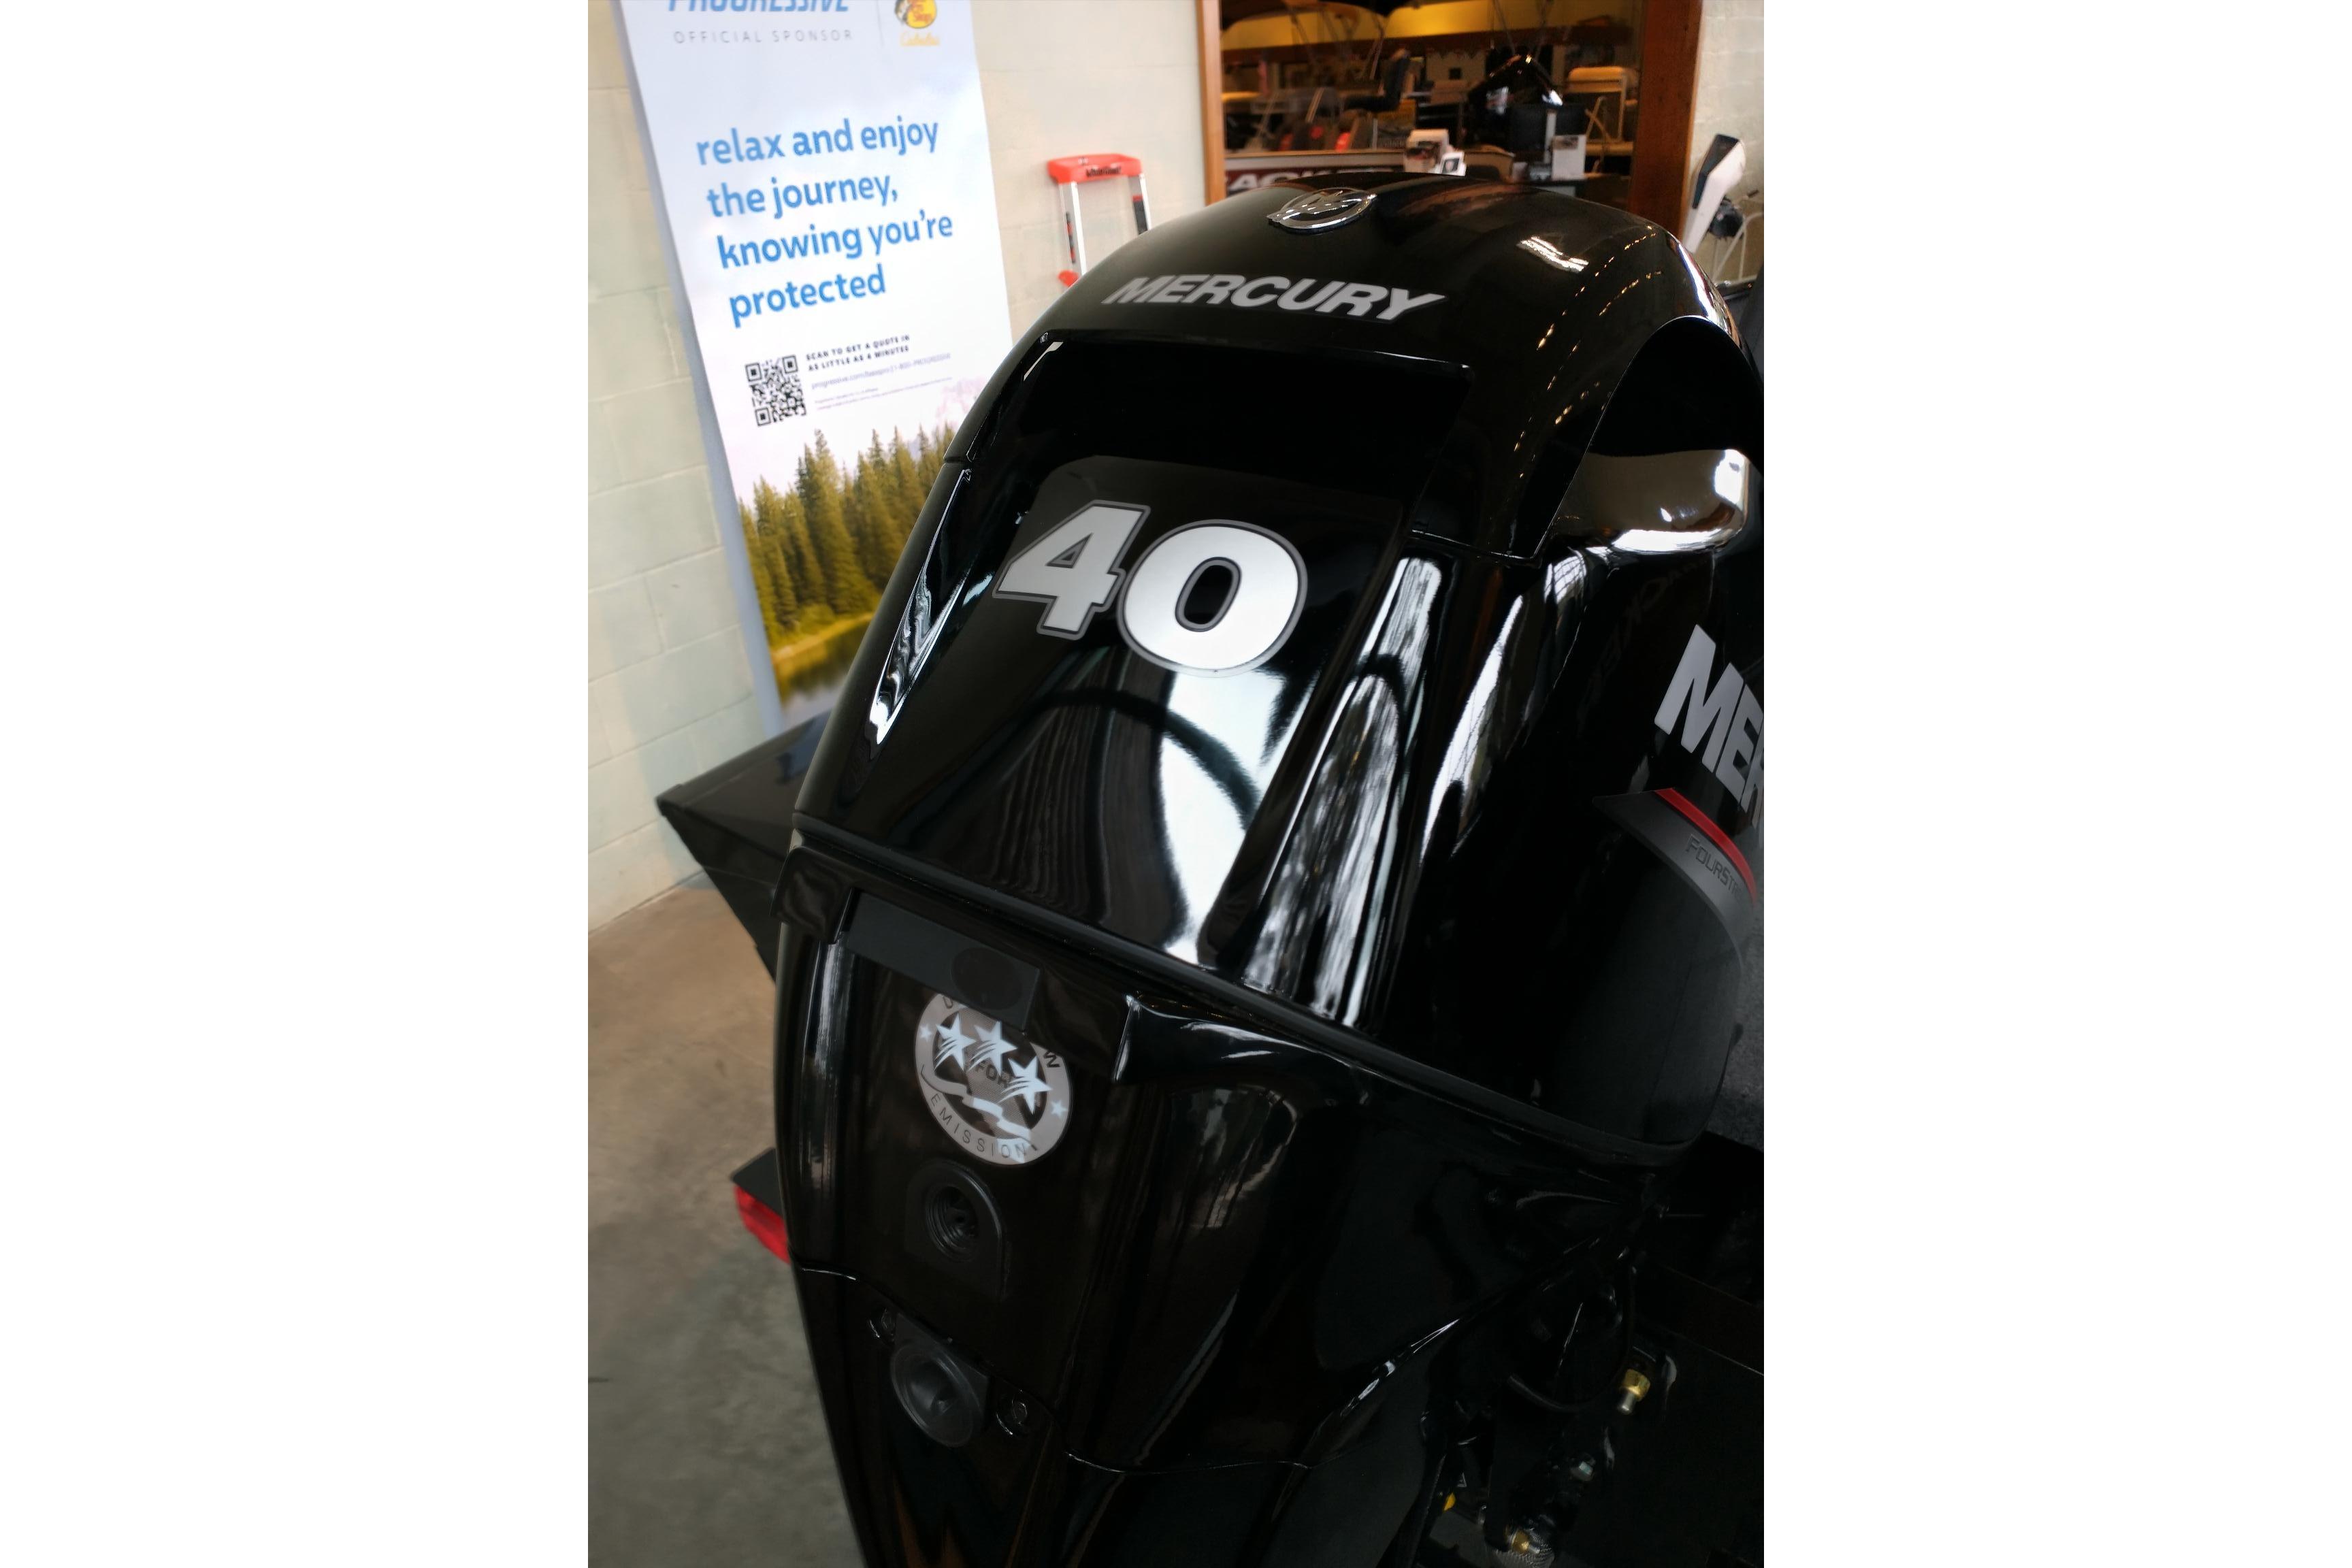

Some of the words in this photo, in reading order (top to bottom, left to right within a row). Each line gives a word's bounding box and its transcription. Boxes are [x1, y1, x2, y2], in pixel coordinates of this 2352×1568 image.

[673, 31, 762, 44] OFFICIAL
[772, 29, 853, 42] SPONSOR
[696, 128, 785, 166] relax
[792, 118, 854, 155] and
[860, 115, 938, 155] enjoy
[706, 182, 765, 218] the
[771, 175, 898, 219] journey,
[717, 225, 862, 269] knowing
[729, 263, 886, 328] protected
[1101, 274, 1446, 321] MERCURY
[806, 350, 829, 361] SCAN
[831, 347, 843, 355] TO
[845, 343, 862, 353] GET
[872, 336, 898, 349] QUOTE
[808, 363, 819, 372] AS
[821, 357, 850, 369] LITTLE
[853, 354, 864, 362] AS
[874, 344, 909, 359] MINUTES
[993, 499, 1308, 677] 40
[930, 1092, 1028, 1159] EMISSION
